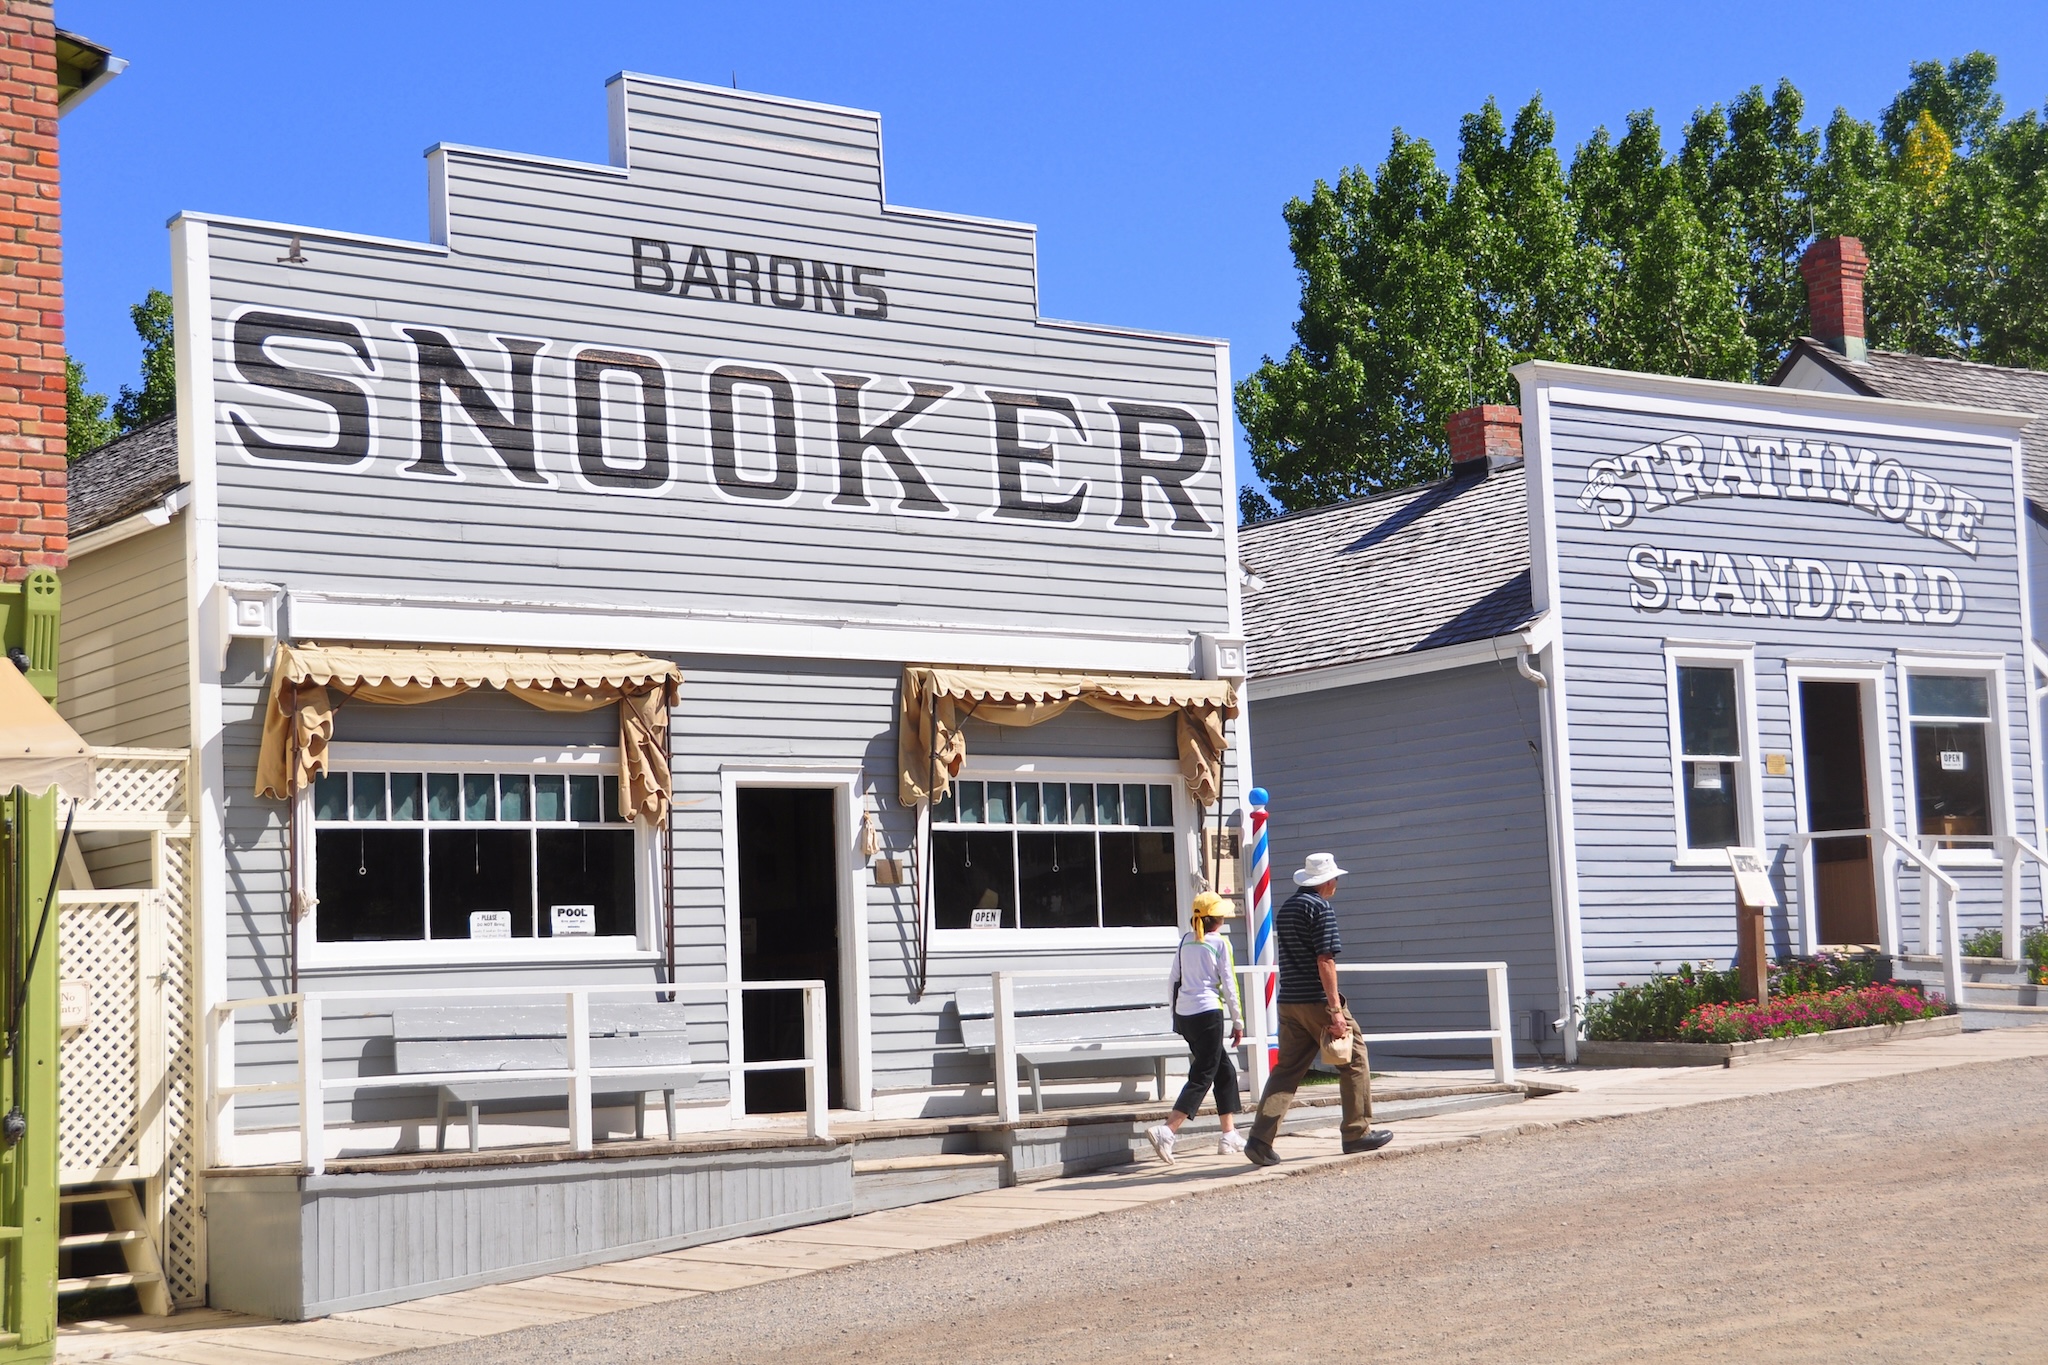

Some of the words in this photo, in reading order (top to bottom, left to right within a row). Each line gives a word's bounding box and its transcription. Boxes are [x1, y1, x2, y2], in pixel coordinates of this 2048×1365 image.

[631, 237, 889, 321] BARONS
[224, 305, 1216, 535] SNOOKER
[1587, 434, 1986, 561] STRATHMORE
[1626, 543, 1966, 626] STANDARD
[1943, 753, 1961, 763] OPEN
[557, 908, 588, 917] POOL
[975, 911, 997, 922] OPEN
[61, 992, 75, 1001] No
[61, 1005, 82, 1015] ntry
